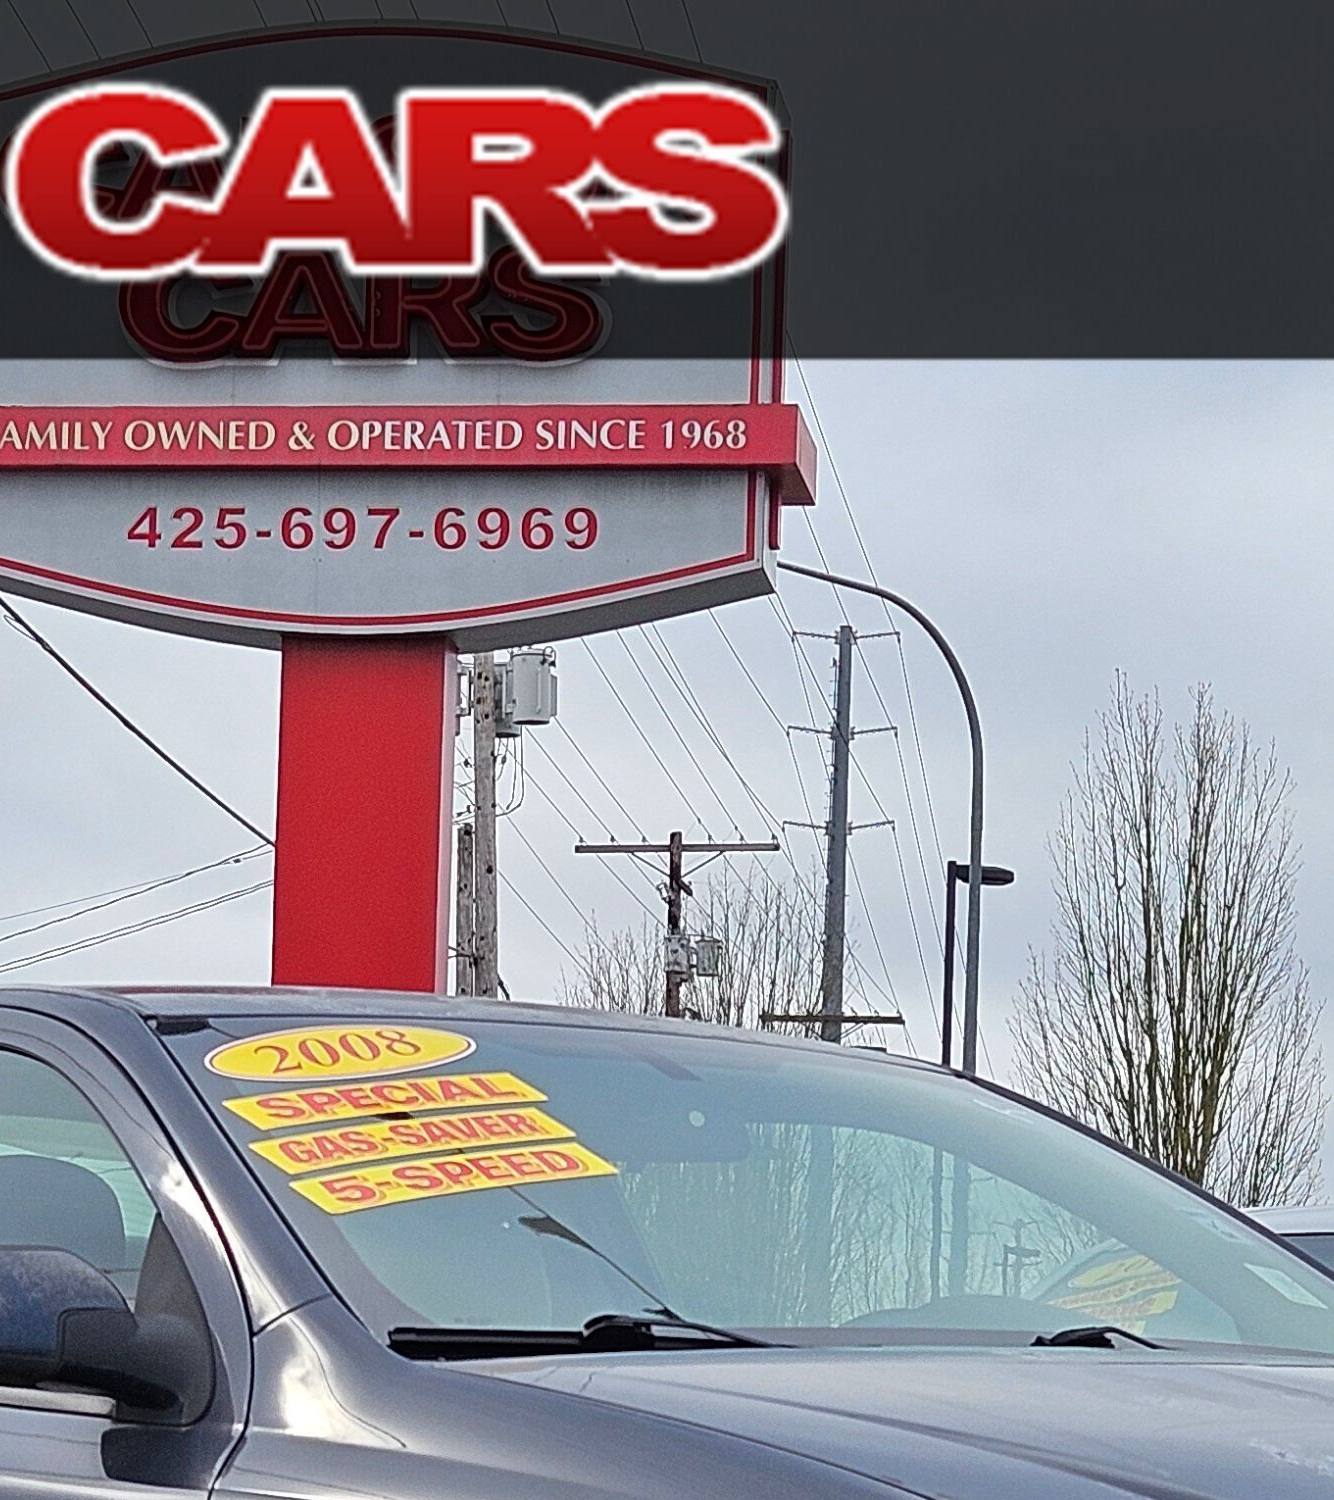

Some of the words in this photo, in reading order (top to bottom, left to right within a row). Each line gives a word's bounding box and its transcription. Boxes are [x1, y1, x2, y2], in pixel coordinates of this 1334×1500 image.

[123, 420, 278, 453] OWNED
[288, 420, 317, 453] &
[326, 421, 523, 453] OPERATED
[534, 419, 648, 452] SINCE
[660, 419, 749, 452] 1968
[127, 507, 600, 551] 425-697-6969
[253, 1030, 422, 1075] 2008
[257, 1077, 519, 1121] SPECIAL
[279, 1112, 540, 1165] GAS-SAVER
[320, 1150, 581, 1205] 5-SPEED
